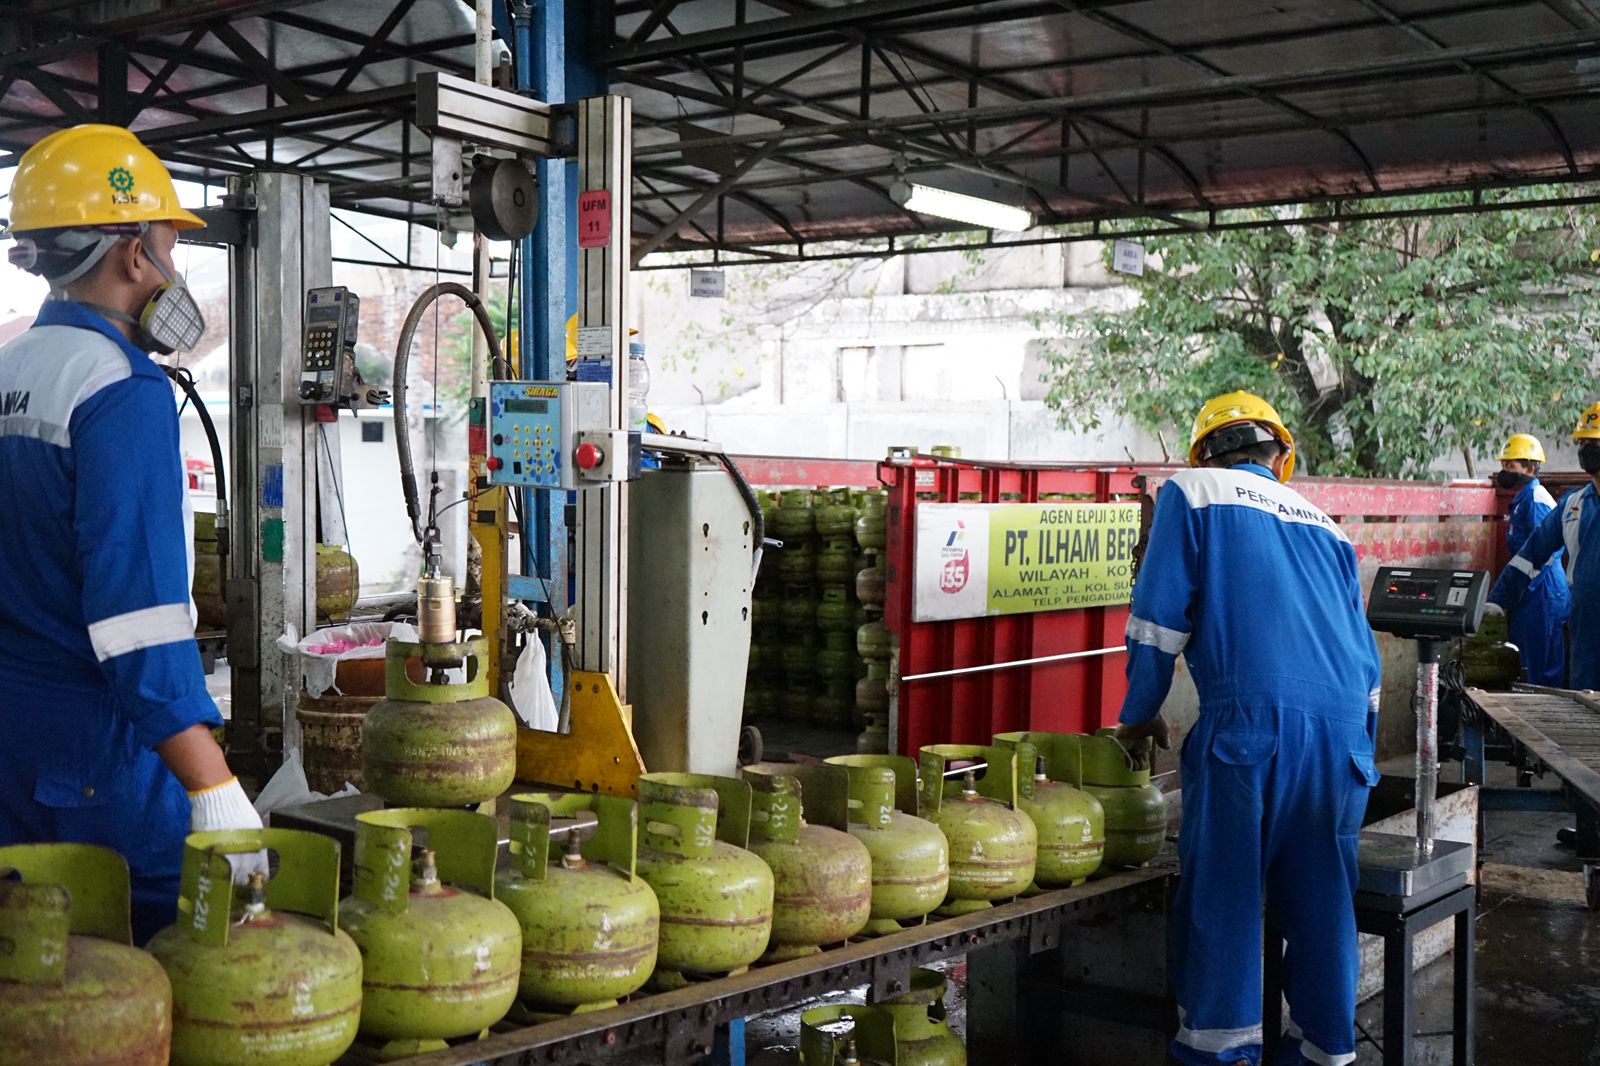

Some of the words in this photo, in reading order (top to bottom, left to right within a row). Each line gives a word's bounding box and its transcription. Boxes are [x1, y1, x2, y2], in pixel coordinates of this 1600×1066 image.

[583, 199, 606, 211] UFM
[588, 220, 600, 232] 11
[1235, 486, 1331, 527] PERTAMINA
[1040, 509, 1072, 524] AGEN
[1077, 509, 1106, 524] ELPIJI
[1110, 510, 1116, 523] 3
[1119, 509, 1133, 522] KG
[1005, 529, 1030, 566] PT.
[1038, 528, 1099, 565] ILHAM
[1106, 527, 1141, 561] BER
[1020, 568, 1089, 583] WILAYAH
[993, 586, 1050, 599] ALAMAT
[1062, 585, 1080, 594] JL.
[1085, 583, 1109, 593] KOL
